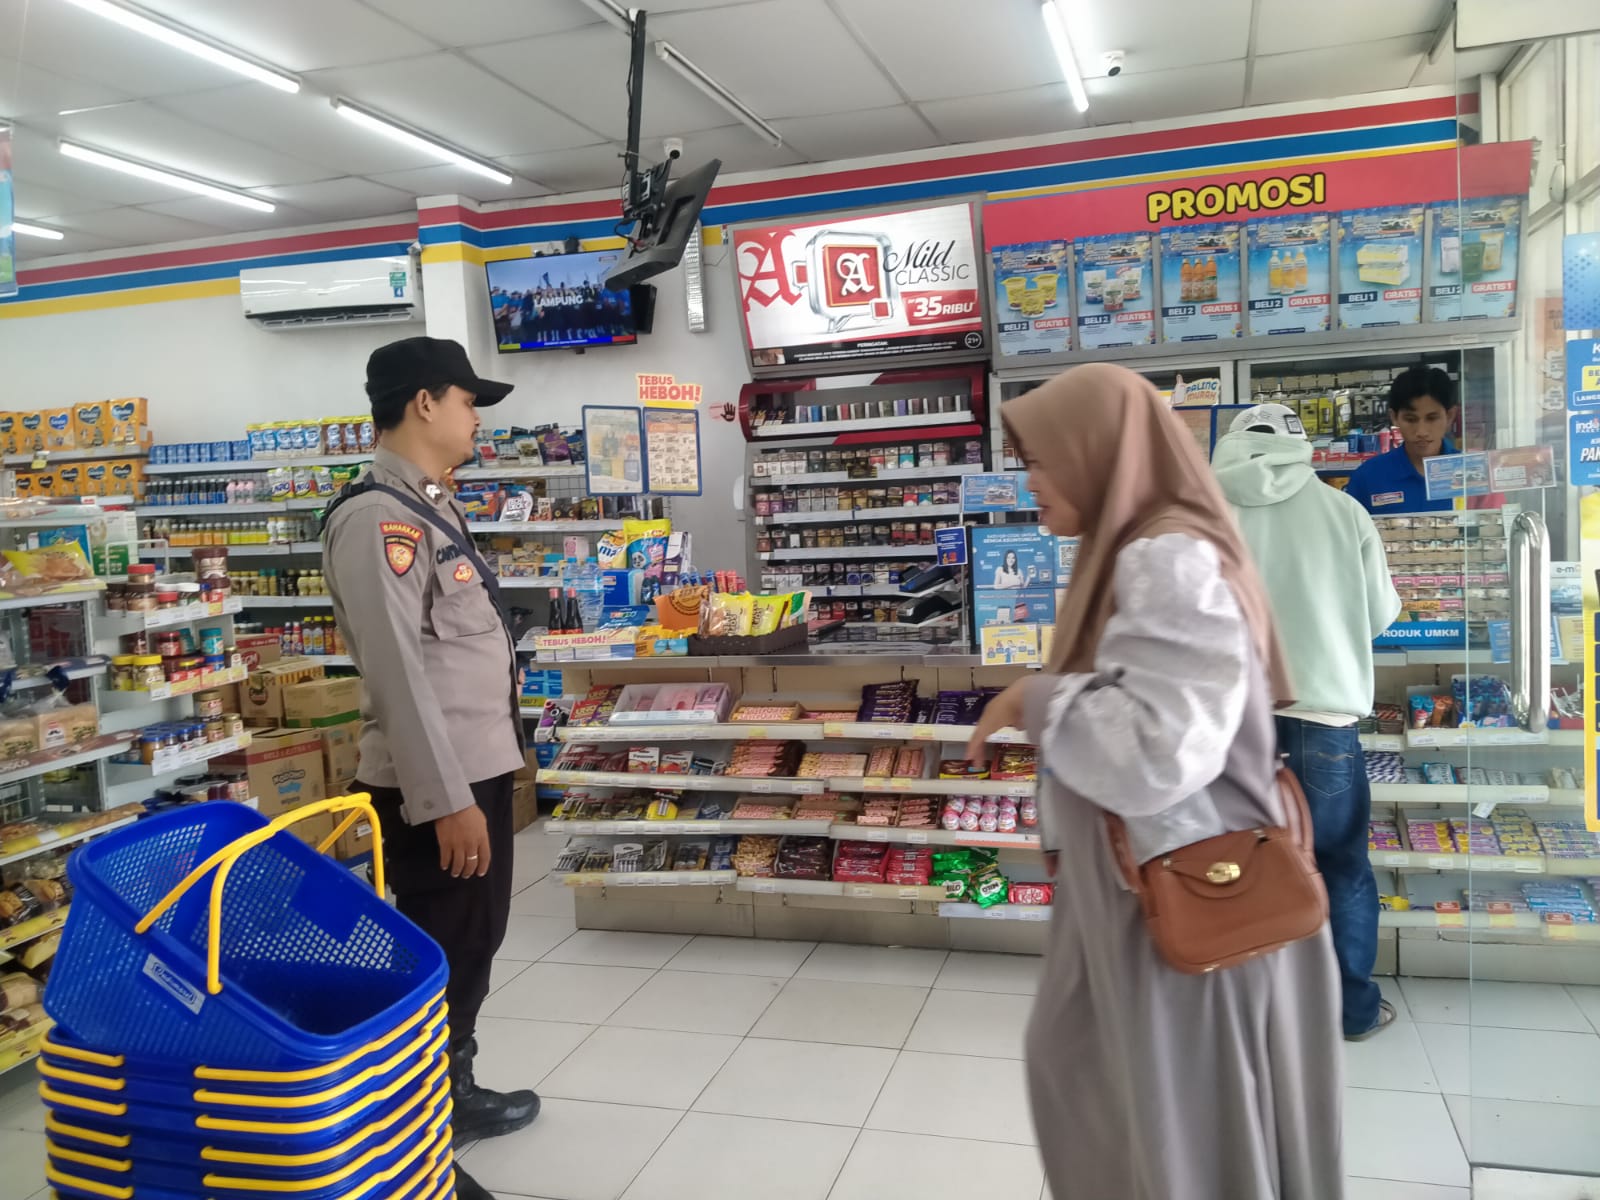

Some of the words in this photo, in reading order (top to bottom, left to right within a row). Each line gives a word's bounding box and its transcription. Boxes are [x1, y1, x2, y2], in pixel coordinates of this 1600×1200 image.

[1147, 172, 1326, 222] PROMOSI
[883, 240, 955, 272] Mild
[895, 264, 970, 286] CLASSIC
[1436, 286, 1453, 294] BELI
[1472, 284, 1504, 293] GRATIS
[1349, 294, 1368, 302] BELI
[1385, 290, 1414, 300] GRATIS
[1255, 300, 1272, 309] BELI
[1290, 297, 1318, 306] GRATIS
[912, 296, 944, 318] 35
[942, 302, 974, 316] RIBU
[1168, 307, 1186, 316] BELI
[1202, 304, 1231, 314] GRATIS
[1084, 317, 1101, 325] BELI
[1117, 313, 1144, 322] GRATIS
[1004, 323, 1020, 332] BELI
[1036, 320, 1063, 329] GRATIS
[638, 375, 673, 385] TEBUS
[1186, 381, 1217, 394] PALING
[639, 385, 700, 402] HEBOH!
[1382, 629, 1421, 638] RODUK
[1424, 629, 1459, 637] UMKM
[543, 638, 568, 647] TEBUS
[571, 635, 606, 645] HEBOH!
[982, 883, 1000, 894] MILO
